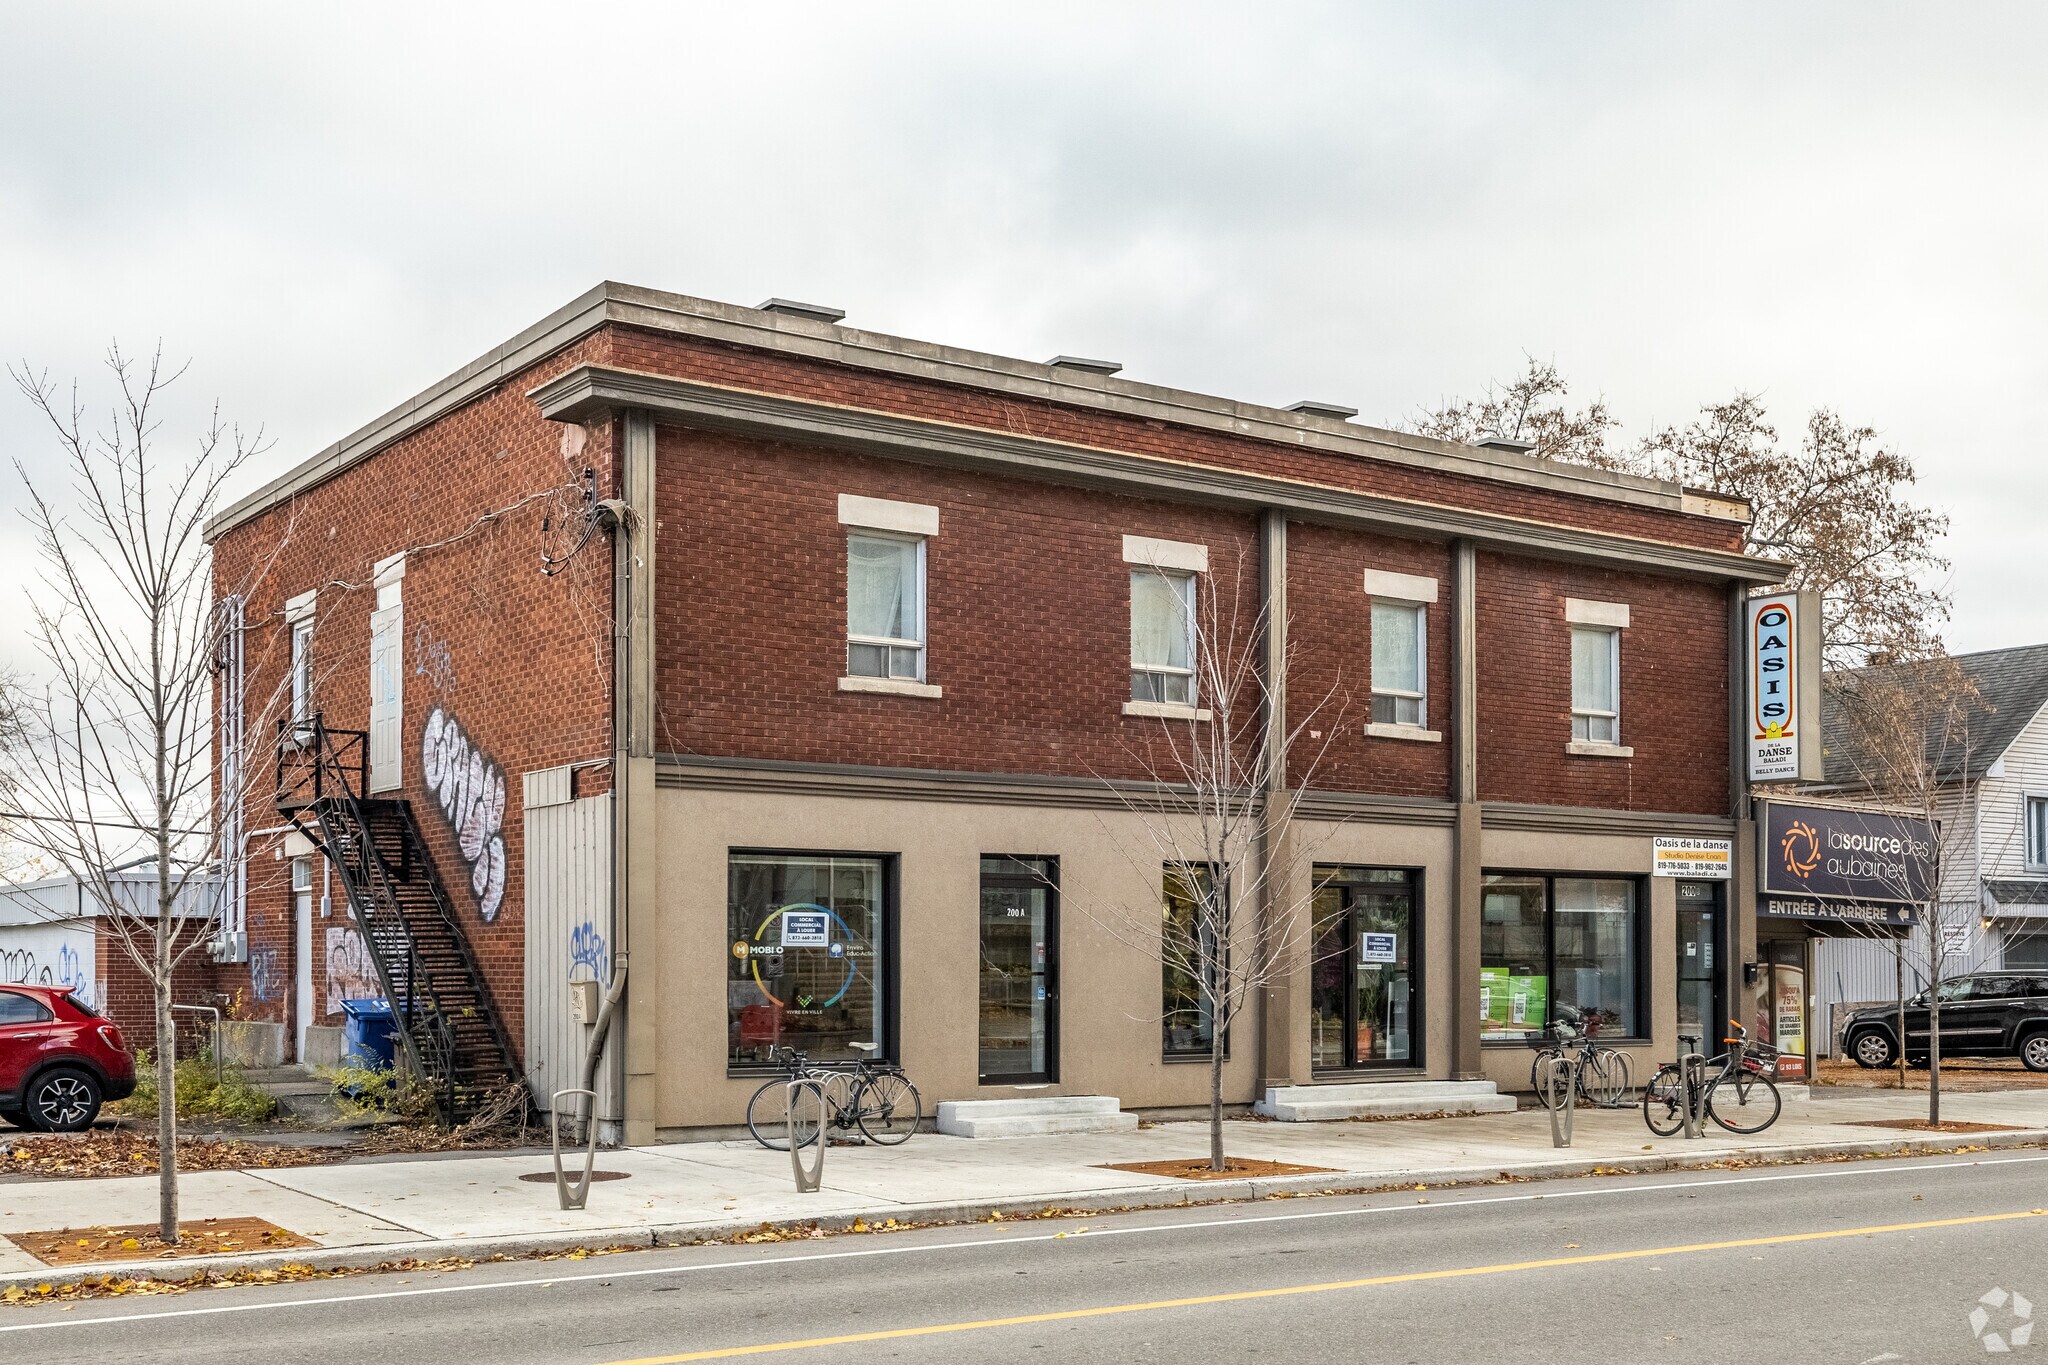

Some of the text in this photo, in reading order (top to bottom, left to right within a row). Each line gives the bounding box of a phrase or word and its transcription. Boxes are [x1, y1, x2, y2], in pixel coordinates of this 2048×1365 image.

[1759, 612, 1787, 718] OASIS
[1758, 747, 1792, 757] DANSE
[1655, 838, 1728, 850] Oasis de la danse
[1007, 908, 1024, 917] 200 A
[1769, 900, 1816, 916] ENTRÉE
[1782, 996, 1798, 1004] 75%
